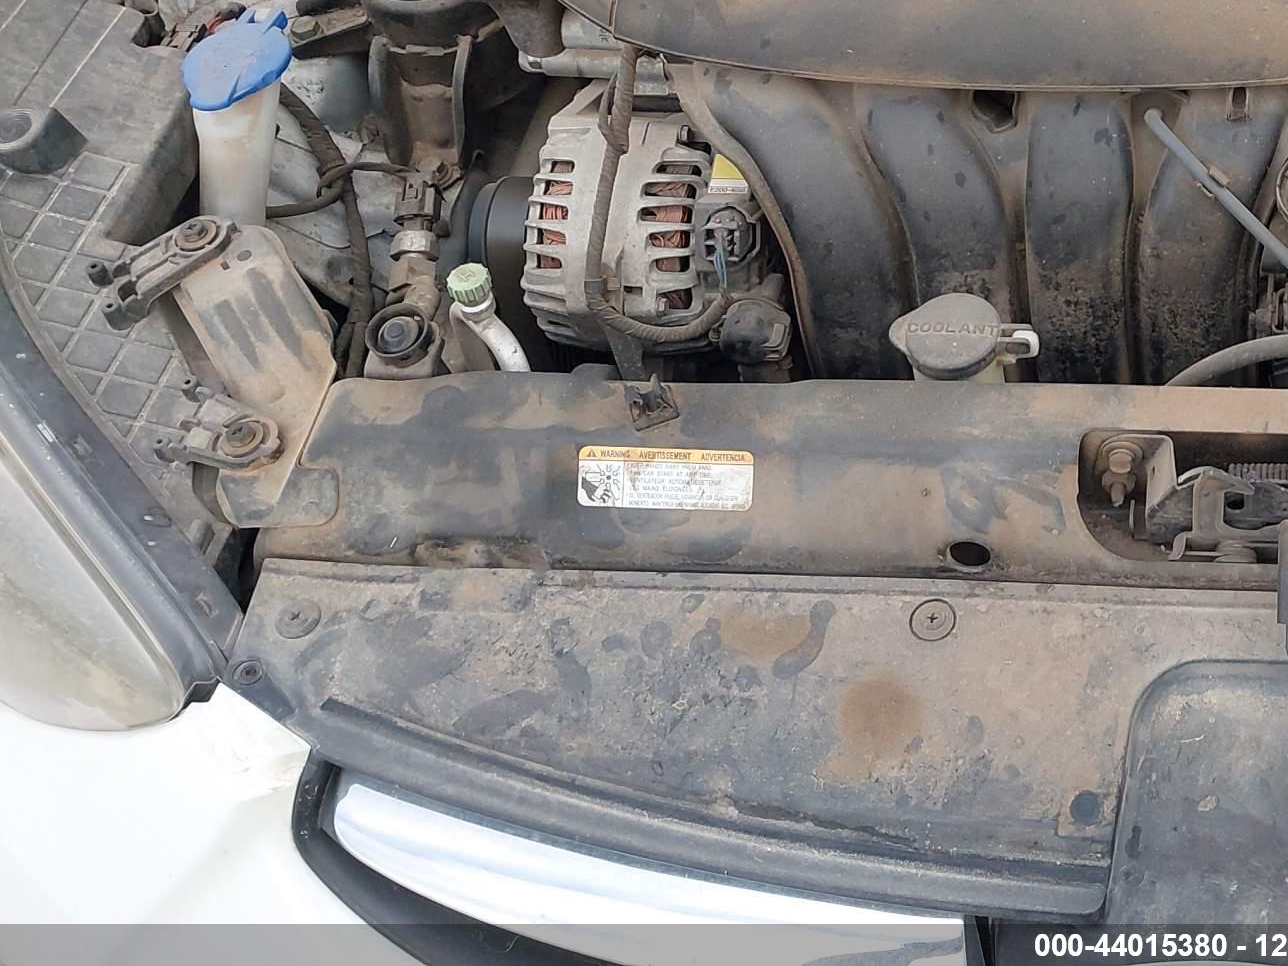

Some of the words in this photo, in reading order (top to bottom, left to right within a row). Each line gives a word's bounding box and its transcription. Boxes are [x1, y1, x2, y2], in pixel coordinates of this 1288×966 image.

[906, 321, 999, 336] COOLANT
[600, 450, 630, 459] WARNING
[639, 451, 691, 461] AVERTISSEMENT
[700, 454, 745, 462] ADVERTENCIA
